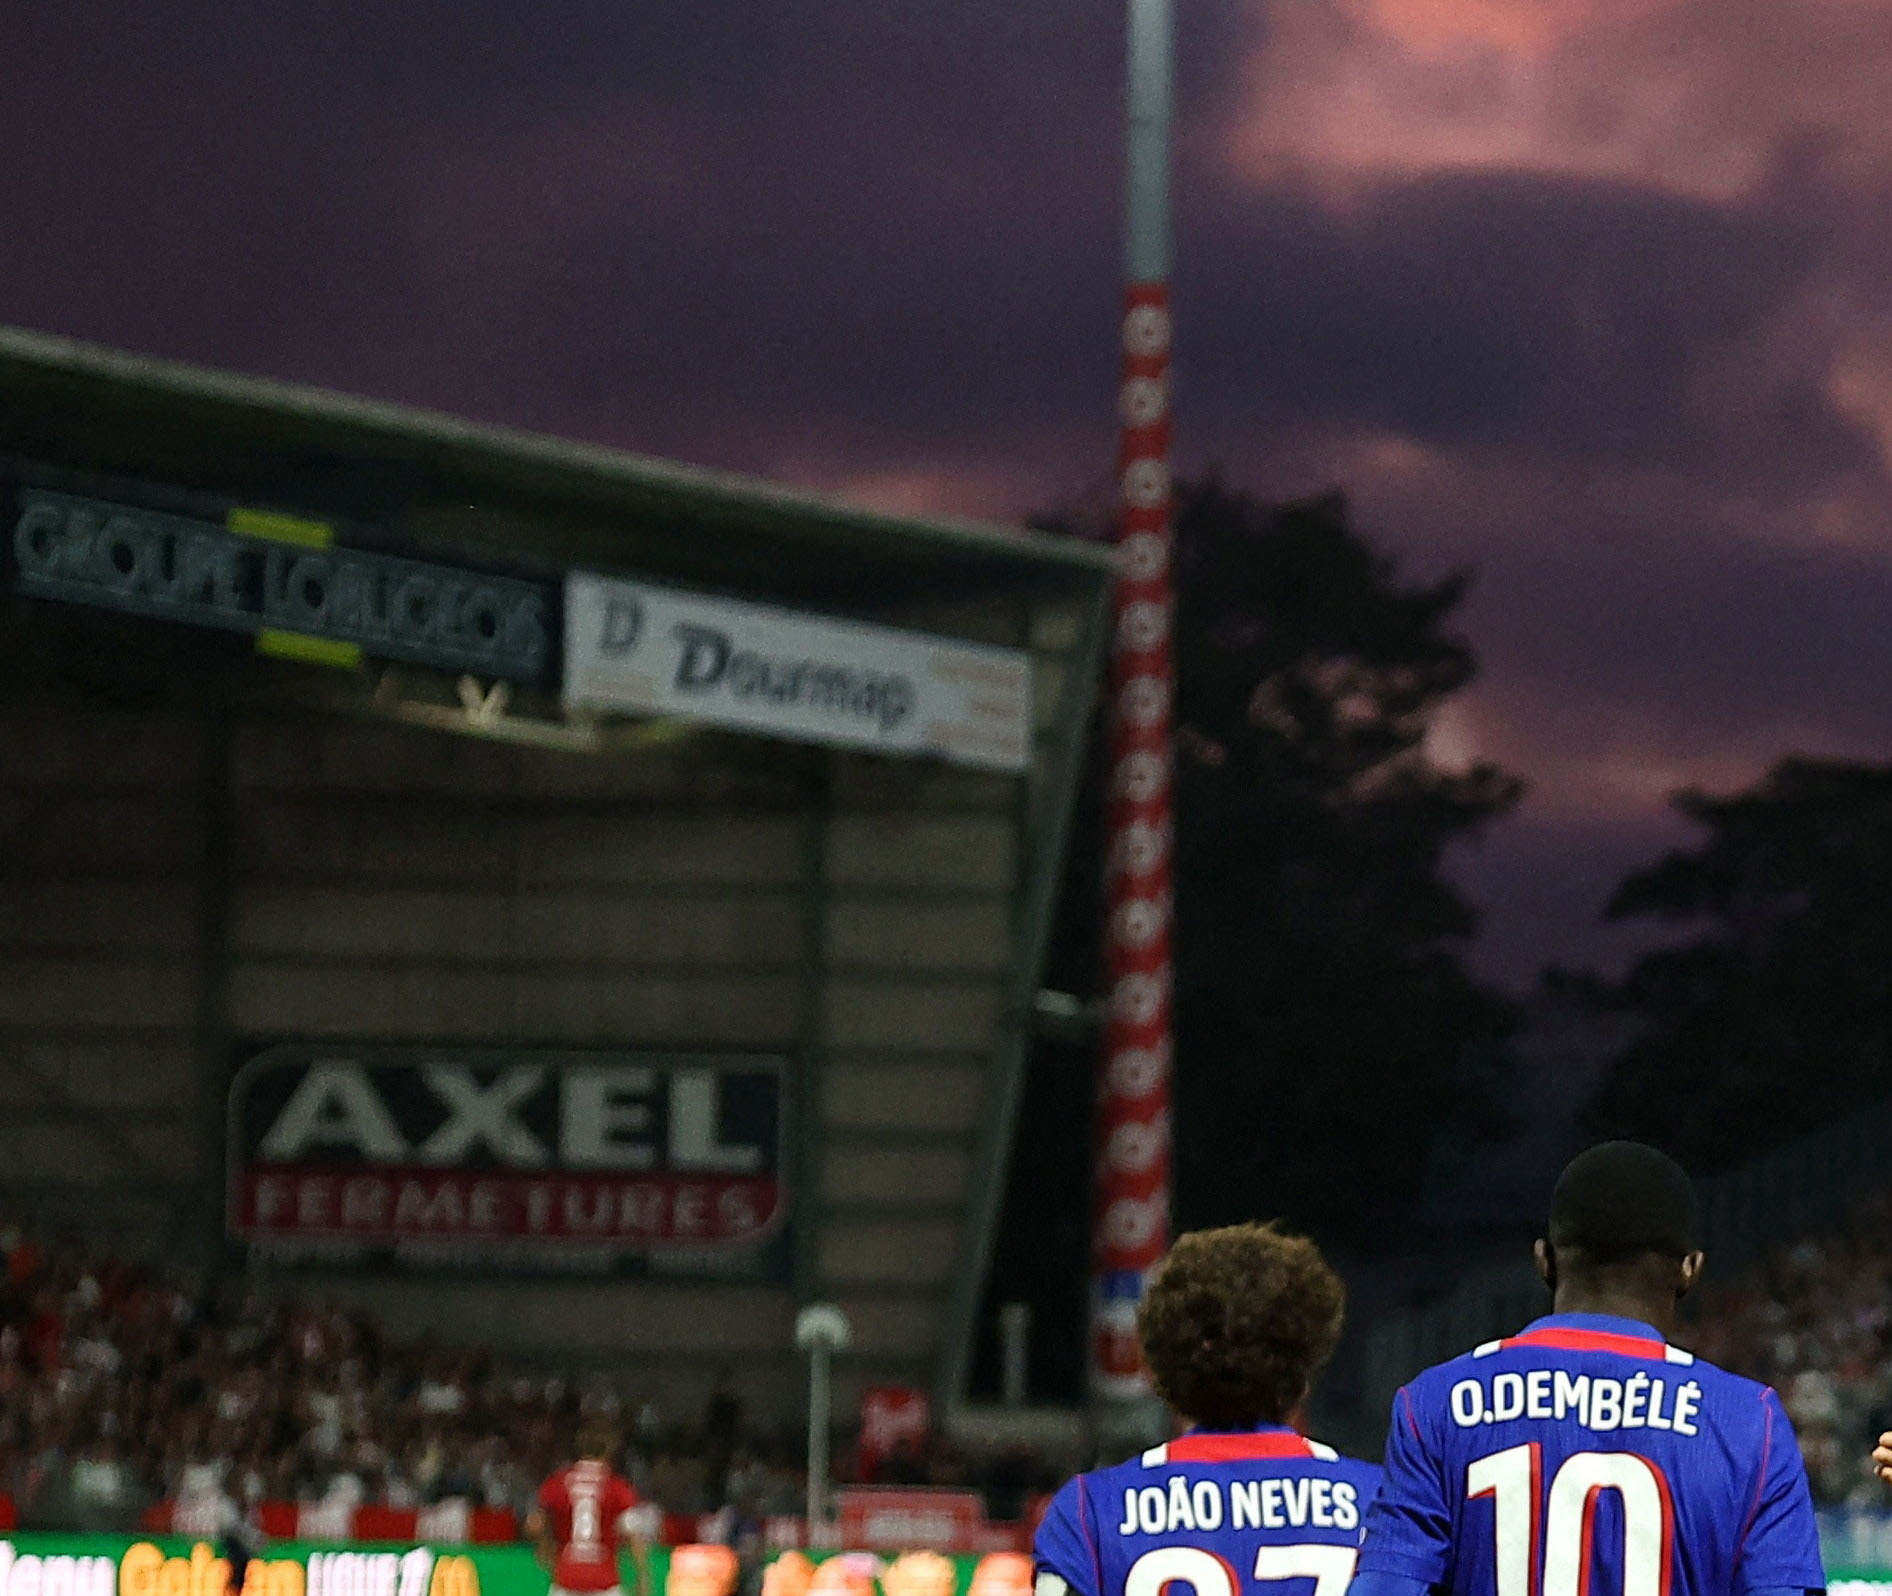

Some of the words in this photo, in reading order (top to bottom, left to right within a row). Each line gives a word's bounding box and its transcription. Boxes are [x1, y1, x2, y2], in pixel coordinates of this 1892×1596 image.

[673, 620, 916, 733] Dourmap
[258, 1059, 762, 1168] AXEL
[254, 1174, 756, 1230] FERMETURES
[1451, 1370, 1702, 1436] O.DEMBÉLÉ
[1120, 1476, 1223, 1535] JOÃO
[1231, 1478, 1360, 1530] NEVES
